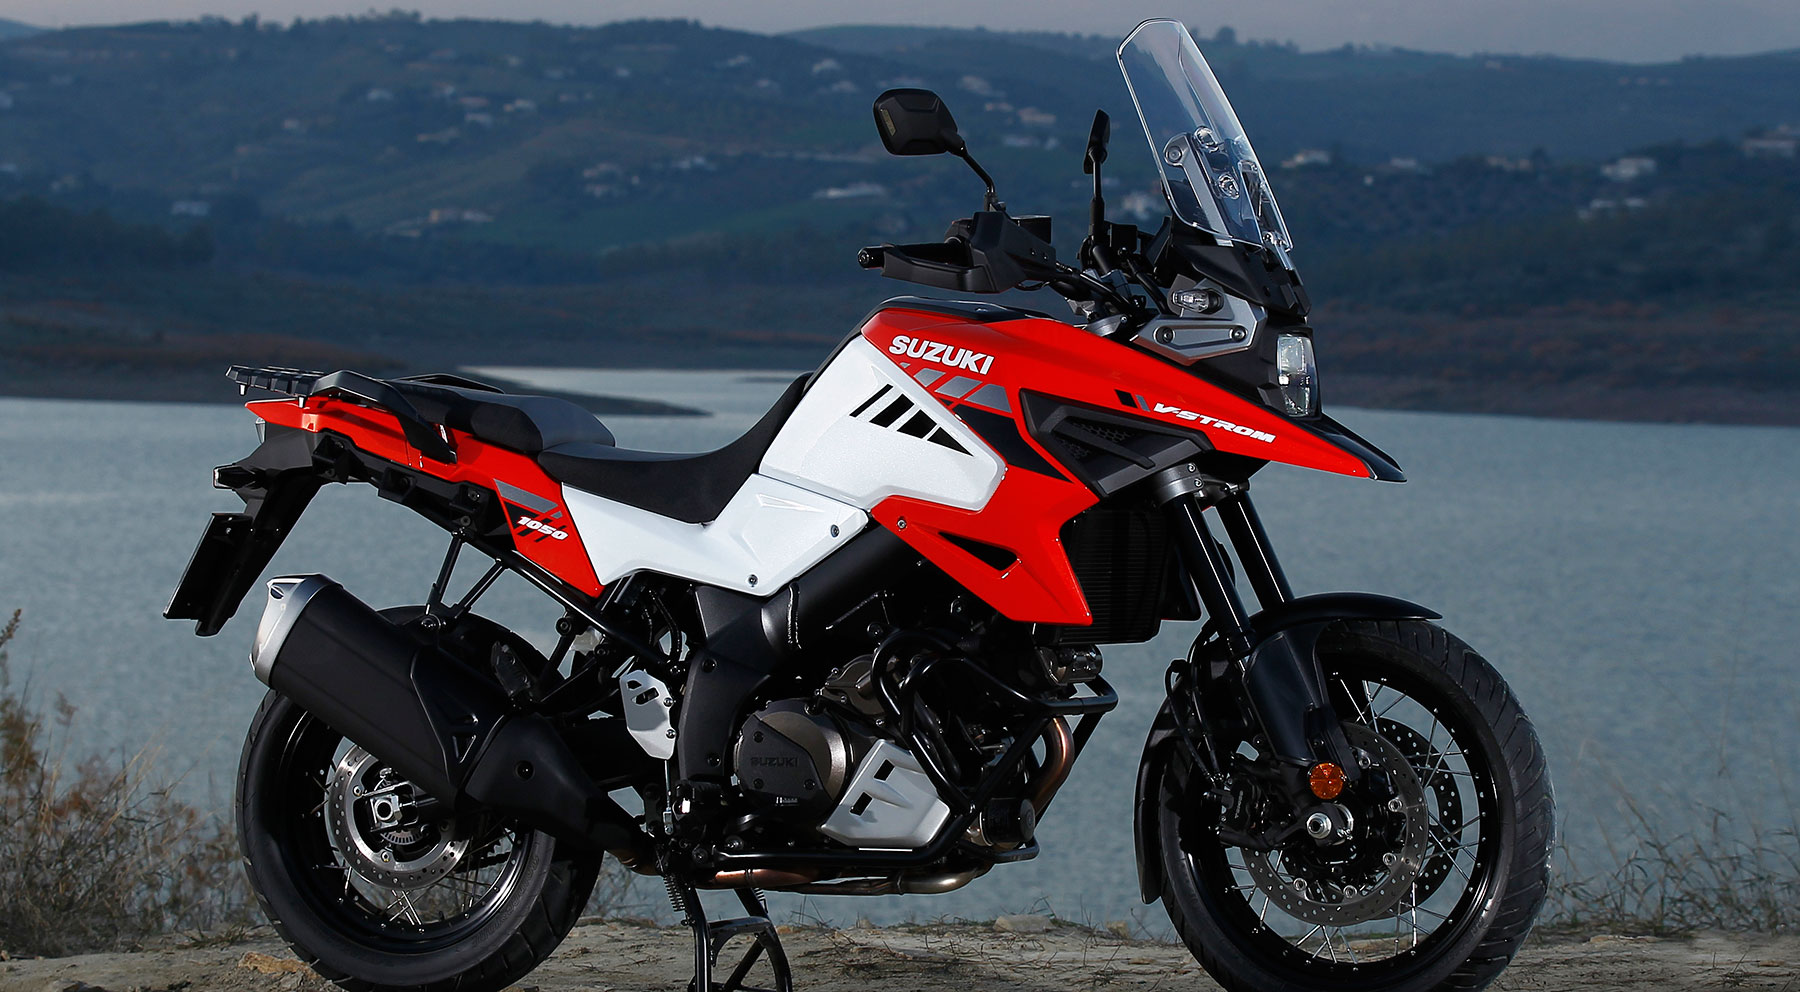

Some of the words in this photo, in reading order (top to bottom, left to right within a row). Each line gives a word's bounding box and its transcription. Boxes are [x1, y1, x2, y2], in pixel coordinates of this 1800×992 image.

[889, 335, 994, 375] SUZUKI
[1153, 402, 1276, 443] V-STROM
[517, 516, 569, 540] 1050
[751, 756, 799, 768] SUZUKI
